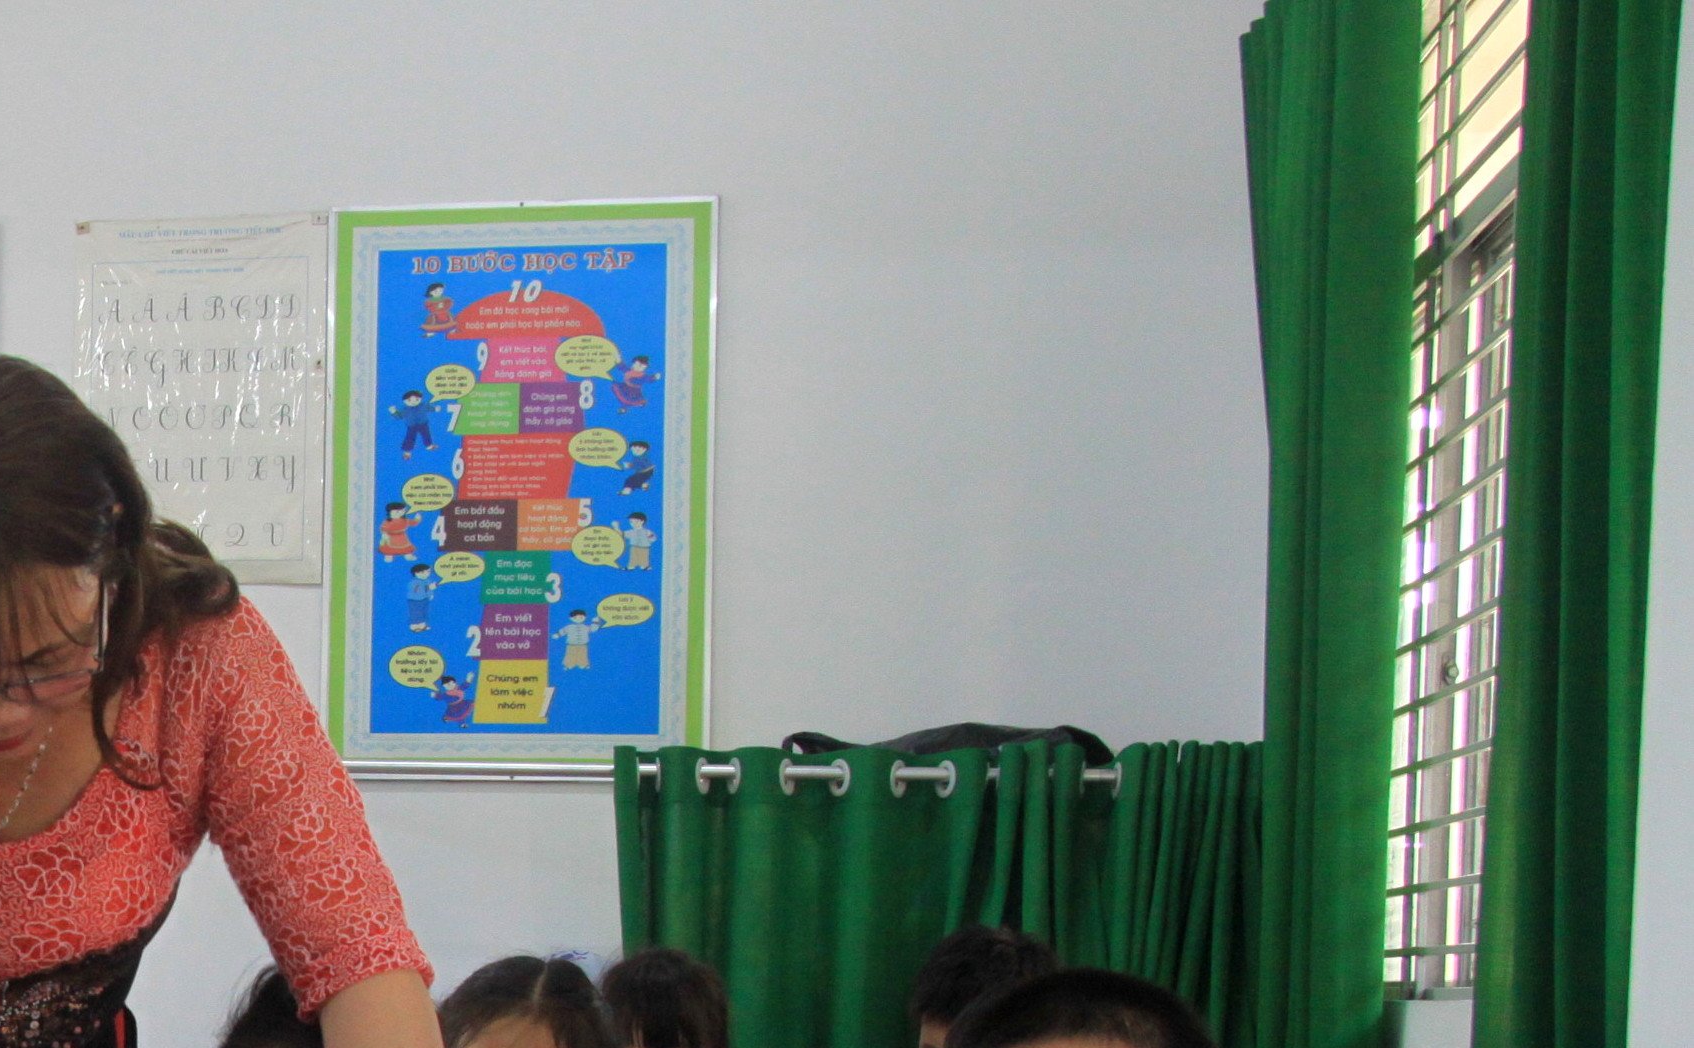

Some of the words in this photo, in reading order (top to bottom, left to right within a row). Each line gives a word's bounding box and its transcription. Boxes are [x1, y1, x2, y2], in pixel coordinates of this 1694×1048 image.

[412, 256, 442, 275] 10
[523, 253, 577, 275] HỌC
[583, 247, 635, 273] TẬP
[509, 279, 543, 303] 10
[477, 342, 488, 371] 9
[579, 380, 594, 410] 8
[447, 404, 462, 432] 7
[452, 449, 464, 480] 6
[577, 498, 593, 527] 5
[431, 515, 447, 546] 4
[545, 573, 561, 603] 3
[495, 613, 512, 622] Em
[466, 625, 481, 657] 2
[539, 687, 555, 718] 1
